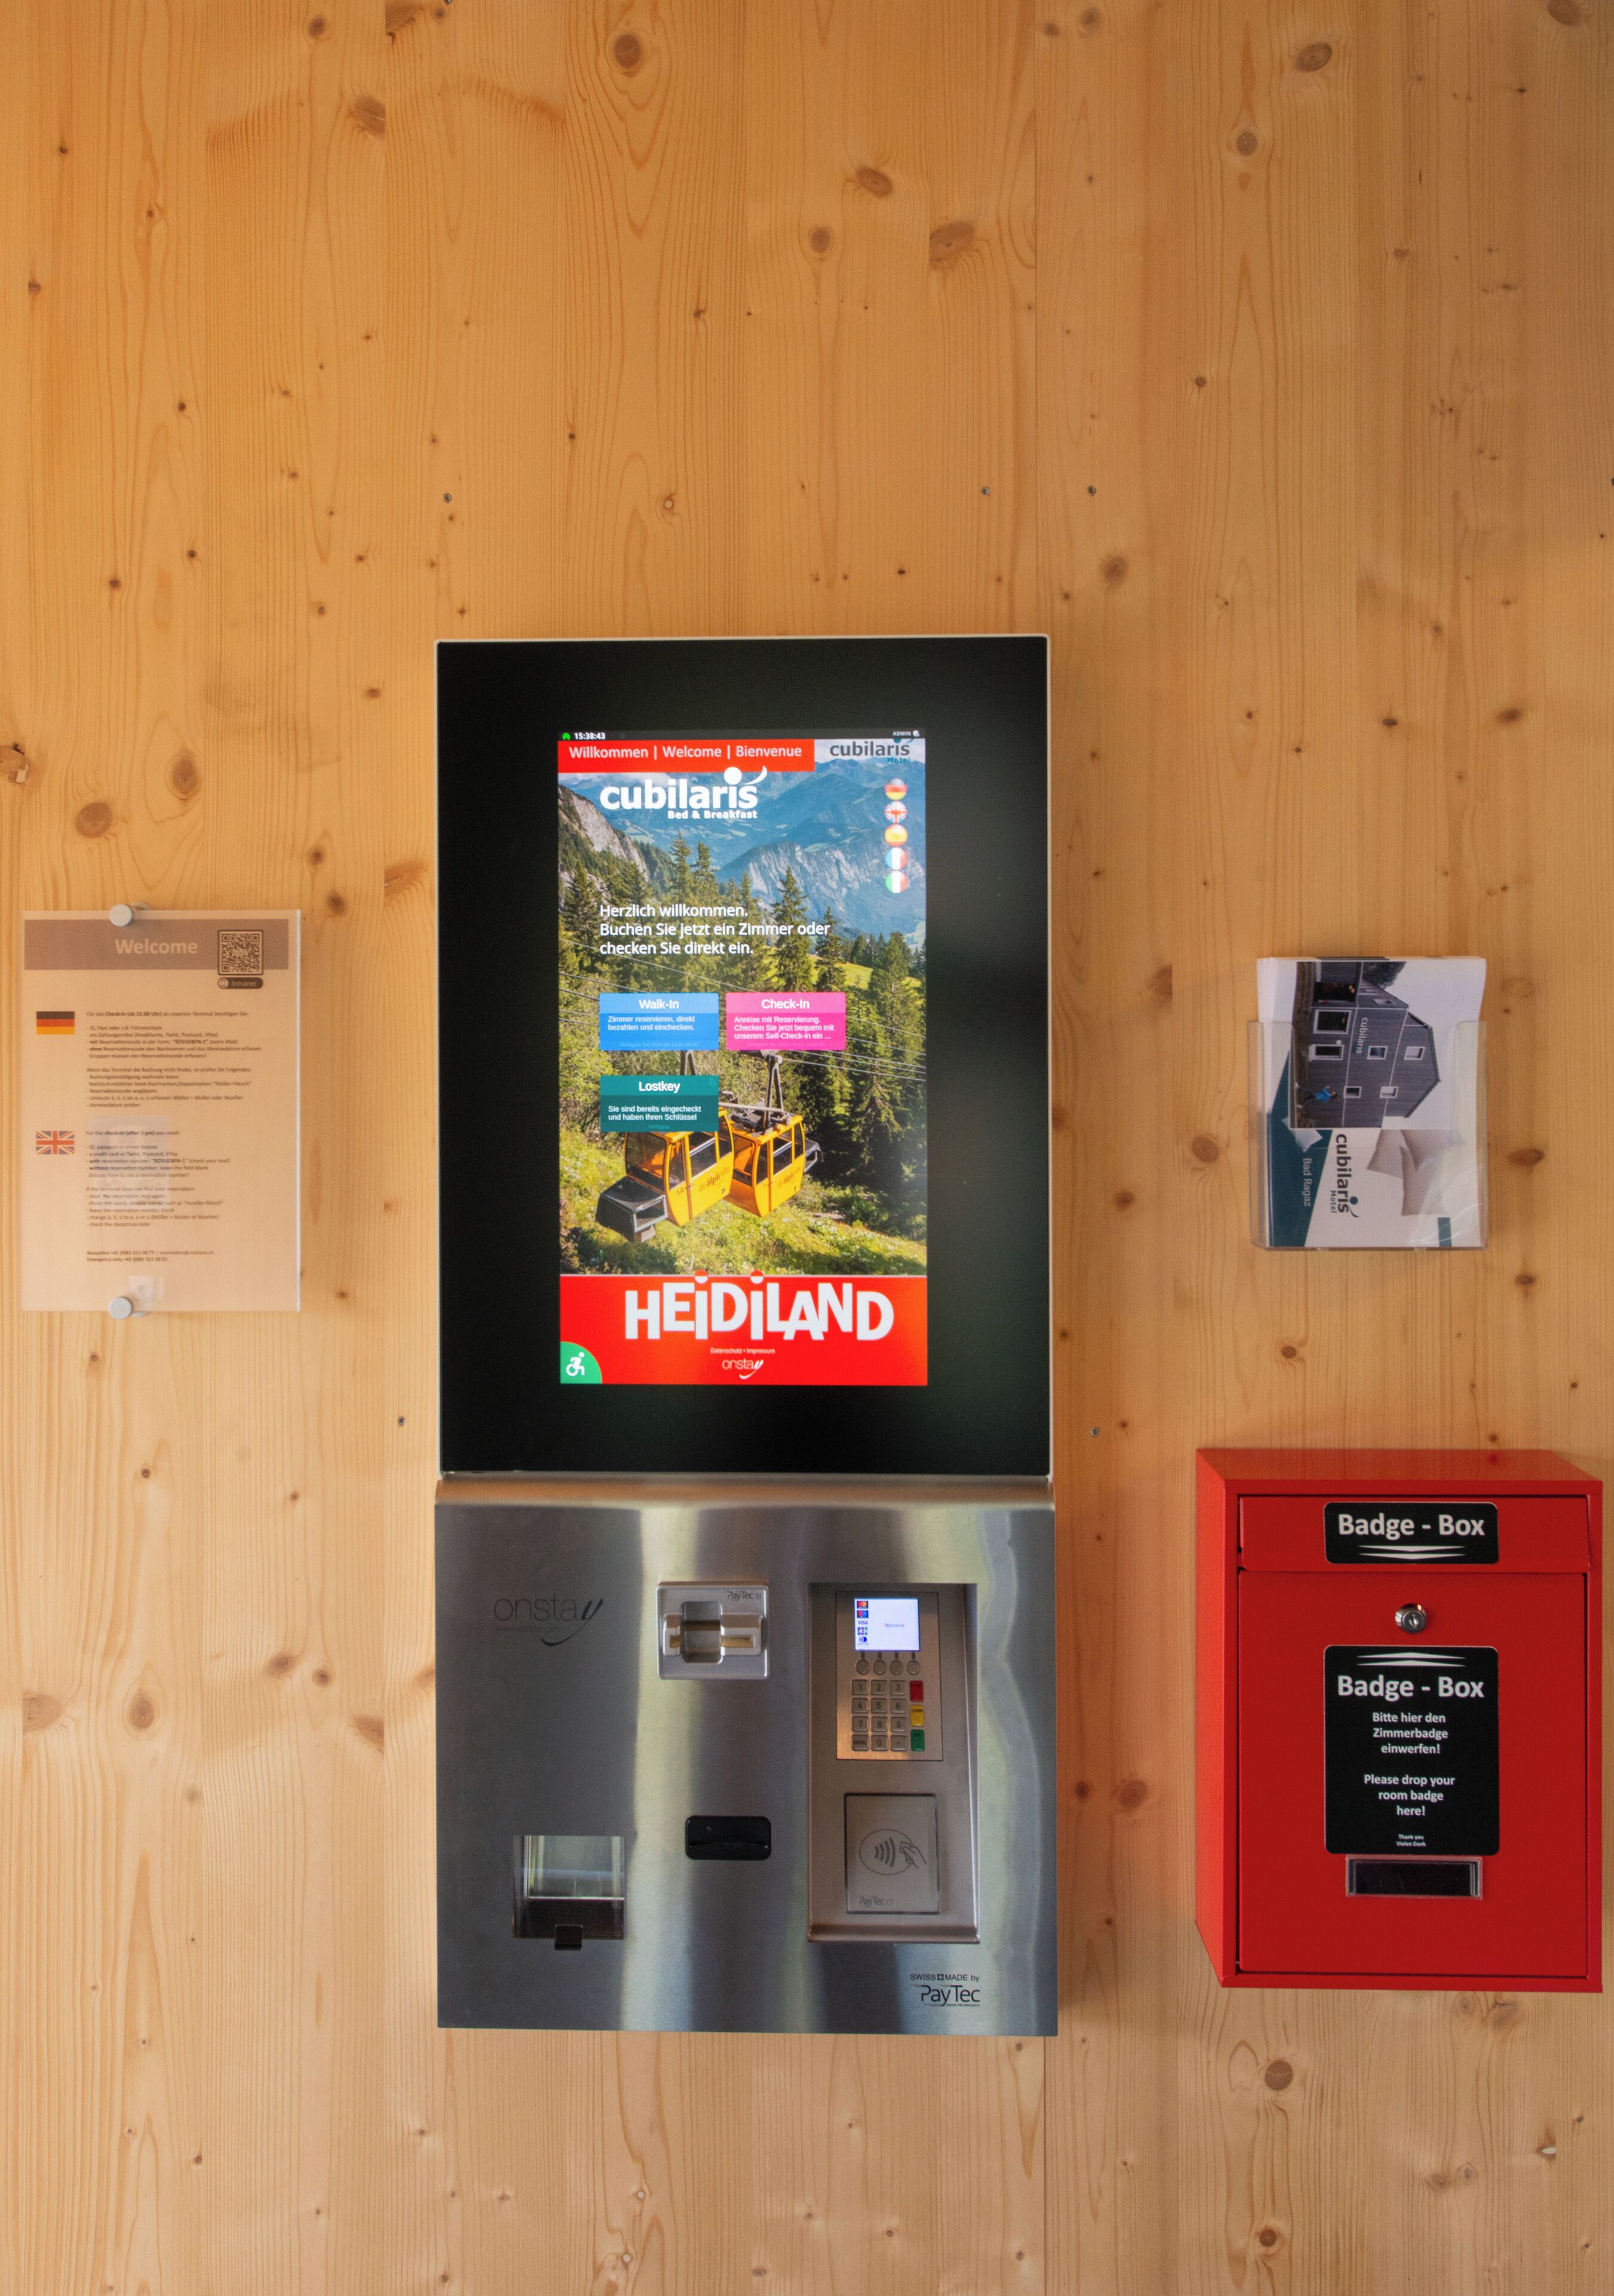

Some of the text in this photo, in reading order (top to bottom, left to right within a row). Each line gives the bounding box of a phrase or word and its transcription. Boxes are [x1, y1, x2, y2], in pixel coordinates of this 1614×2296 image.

[569, 746, 649, 758] Willkommen
[662, 746, 722, 758] Welcome
[736, 745, 802, 757] Bienvenue
[830, 740, 911, 756] cubilaris
[600, 767, 768, 809] cubilaris
[668, 810, 758, 819] Bed & Breakfast
[600, 903, 748, 917] Herzlich willkommen.
[600, 921, 831, 939] Buchen Sie jetzt ein Zimmer oder
[115, 938, 198, 954] Welcome
[600, 941, 754, 955] checken Sie direkt ein.
[638, 999, 680, 1009] Walk-In
[761, 999, 810, 1009] Check-In
[1356, 1017, 1368, 1054] cubilaris
[638, 1081, 681, 1094] Lostkey
[1335, 1134, 1359, 1217] cubilaris
[1301, 1158, 1312, 1207] Bad Ragaz
[1338, 1513, 1415, 1540] Badge
[1438, 1514, 1485, 1535] Box
[726, 1591, 753, 1601] PayTec
[1337, 1674, 1414, 1702] Badge
[1438, 1676, 1484, 1697] Box
[1372, 1712, 1446, 1723] Bitte hier den
[1372, 1728, 1448, 1741] Zimmerbadge
[1381, 1744, 1440, 1754] einwerfen!
[1364, 1774, 1456, 1787] Please drop your
[1378, 1790, 1444, 1802] room badge
[1396, 1805, 1426, 1816] here!
[857, 1896, 885, 1907] PayTec
[971, 1974, 980, 1983] by
[915, 1985, 980, 2007] PayTec
